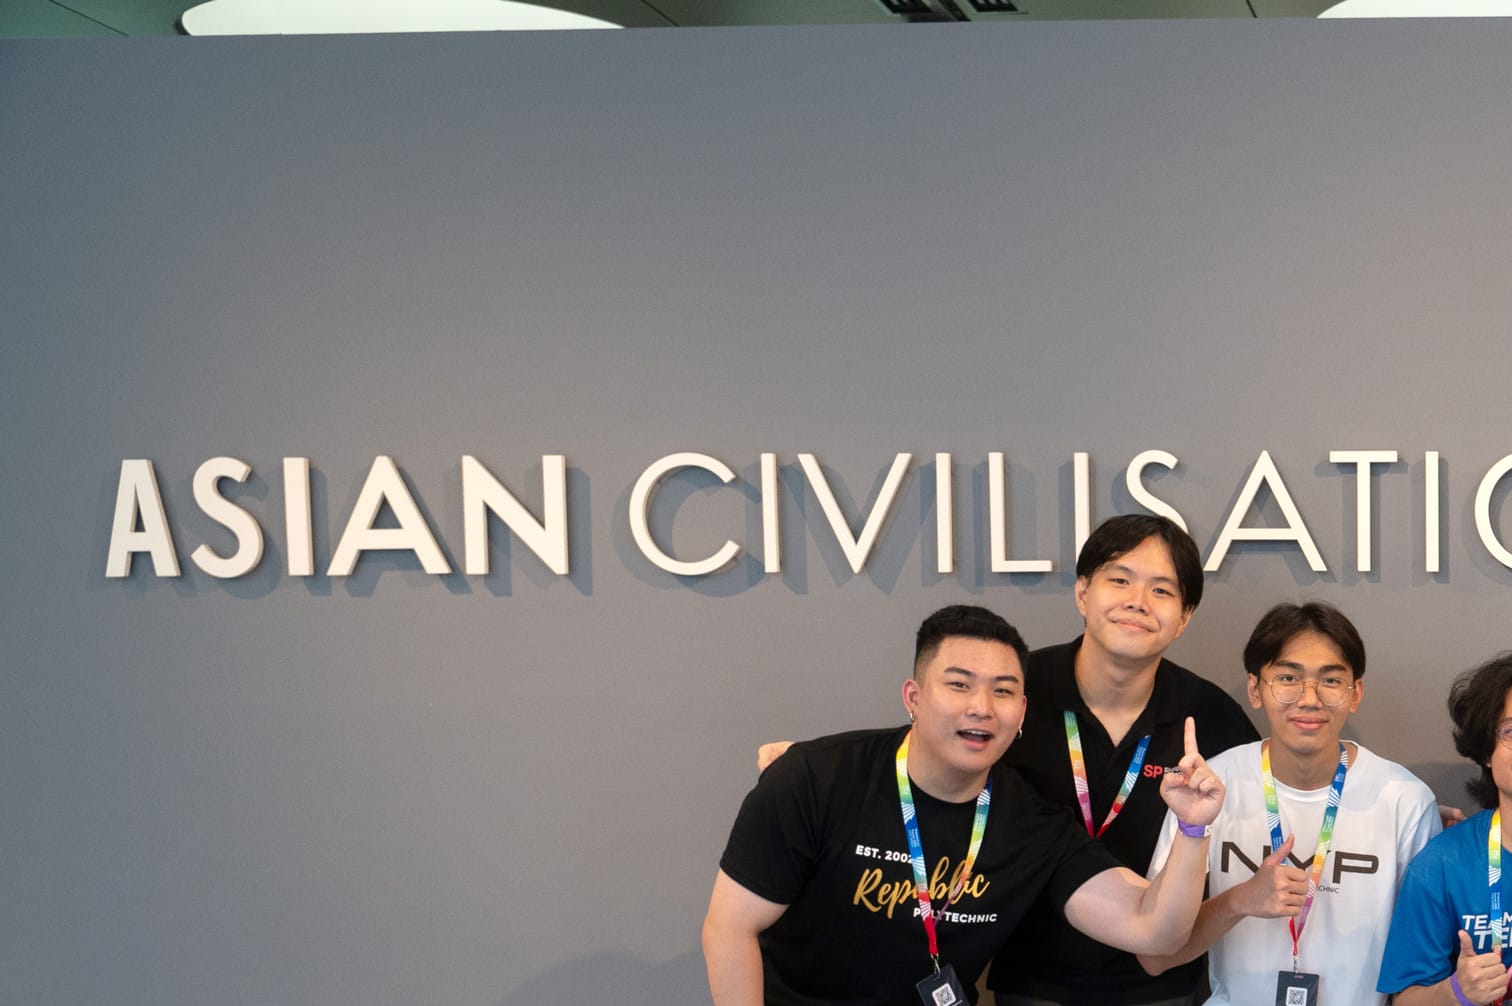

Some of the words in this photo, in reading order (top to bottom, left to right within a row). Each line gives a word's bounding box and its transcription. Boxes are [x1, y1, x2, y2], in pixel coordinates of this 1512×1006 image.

[104, 452, 570, 578] ASIAN
[1143, 764, 1163, 778] SP
[855, 844, 882, 859] EST.
[1221, 841, 1379, 884] NYP
[853, 856, 991, 919] Repblic
[913, 907, 998, 924] PLTECHNIC
